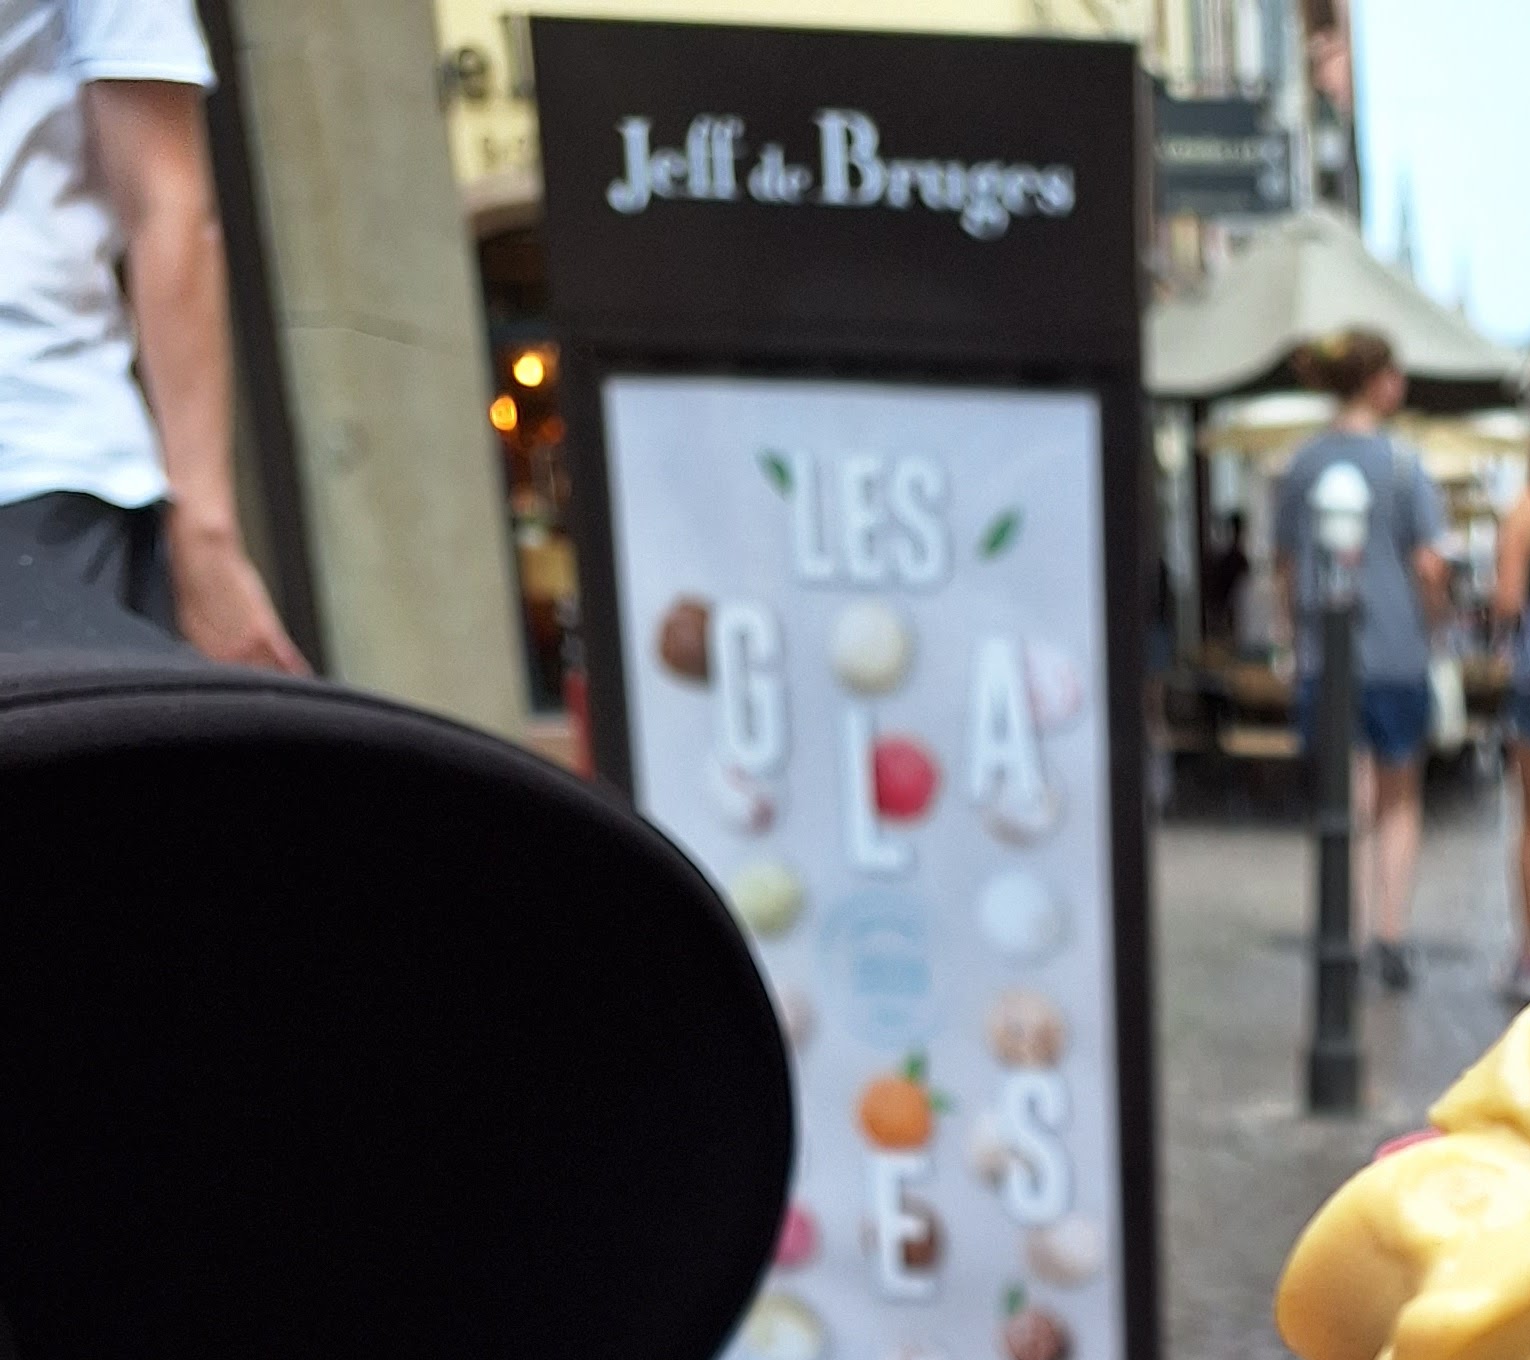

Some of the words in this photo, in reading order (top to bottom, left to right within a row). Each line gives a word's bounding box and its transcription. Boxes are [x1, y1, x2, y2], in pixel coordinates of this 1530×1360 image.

[607, 113, 745, 213] Jeff
[747, 142, 812, 203] de
[813, 108, 1077, 240] Bruges
[795, 448, 951, 584] LES
